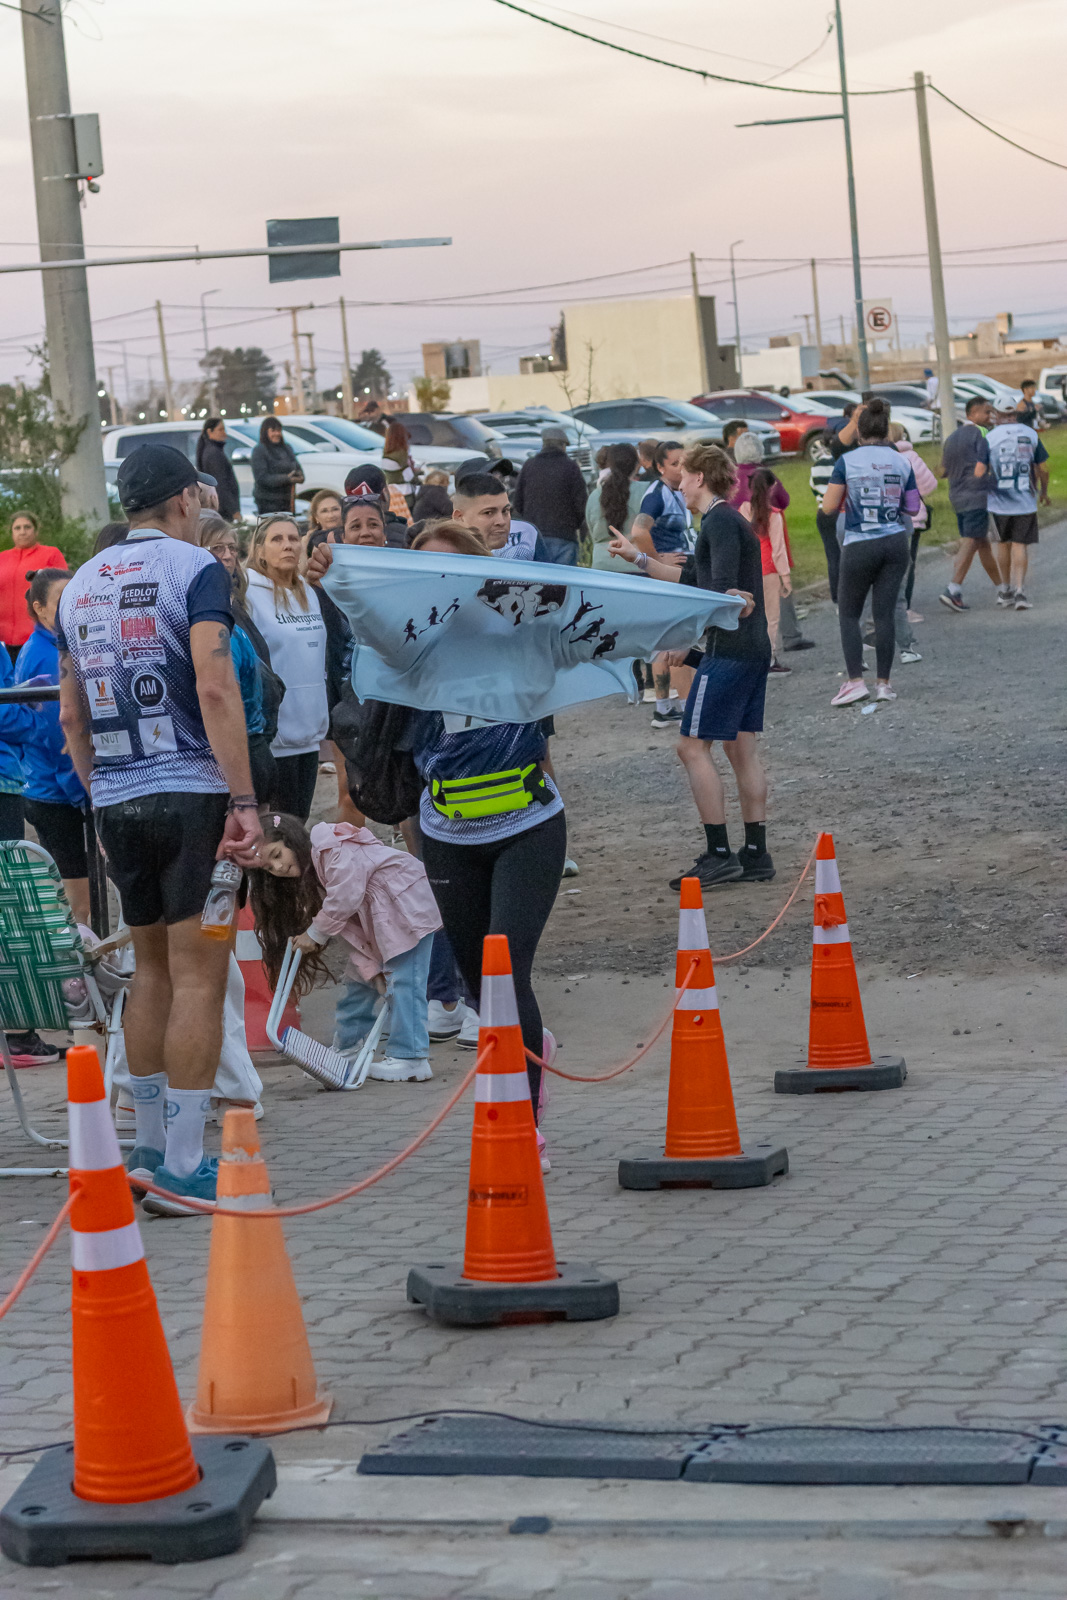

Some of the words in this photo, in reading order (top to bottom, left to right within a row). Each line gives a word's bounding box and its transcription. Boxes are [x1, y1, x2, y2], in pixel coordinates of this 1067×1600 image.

[873, 312, 885, 327] E
[121, 587, 158, 598] FEEDLOT
[140, 679, 158, 697] AM
[100, 733, 119, 745] NUT
